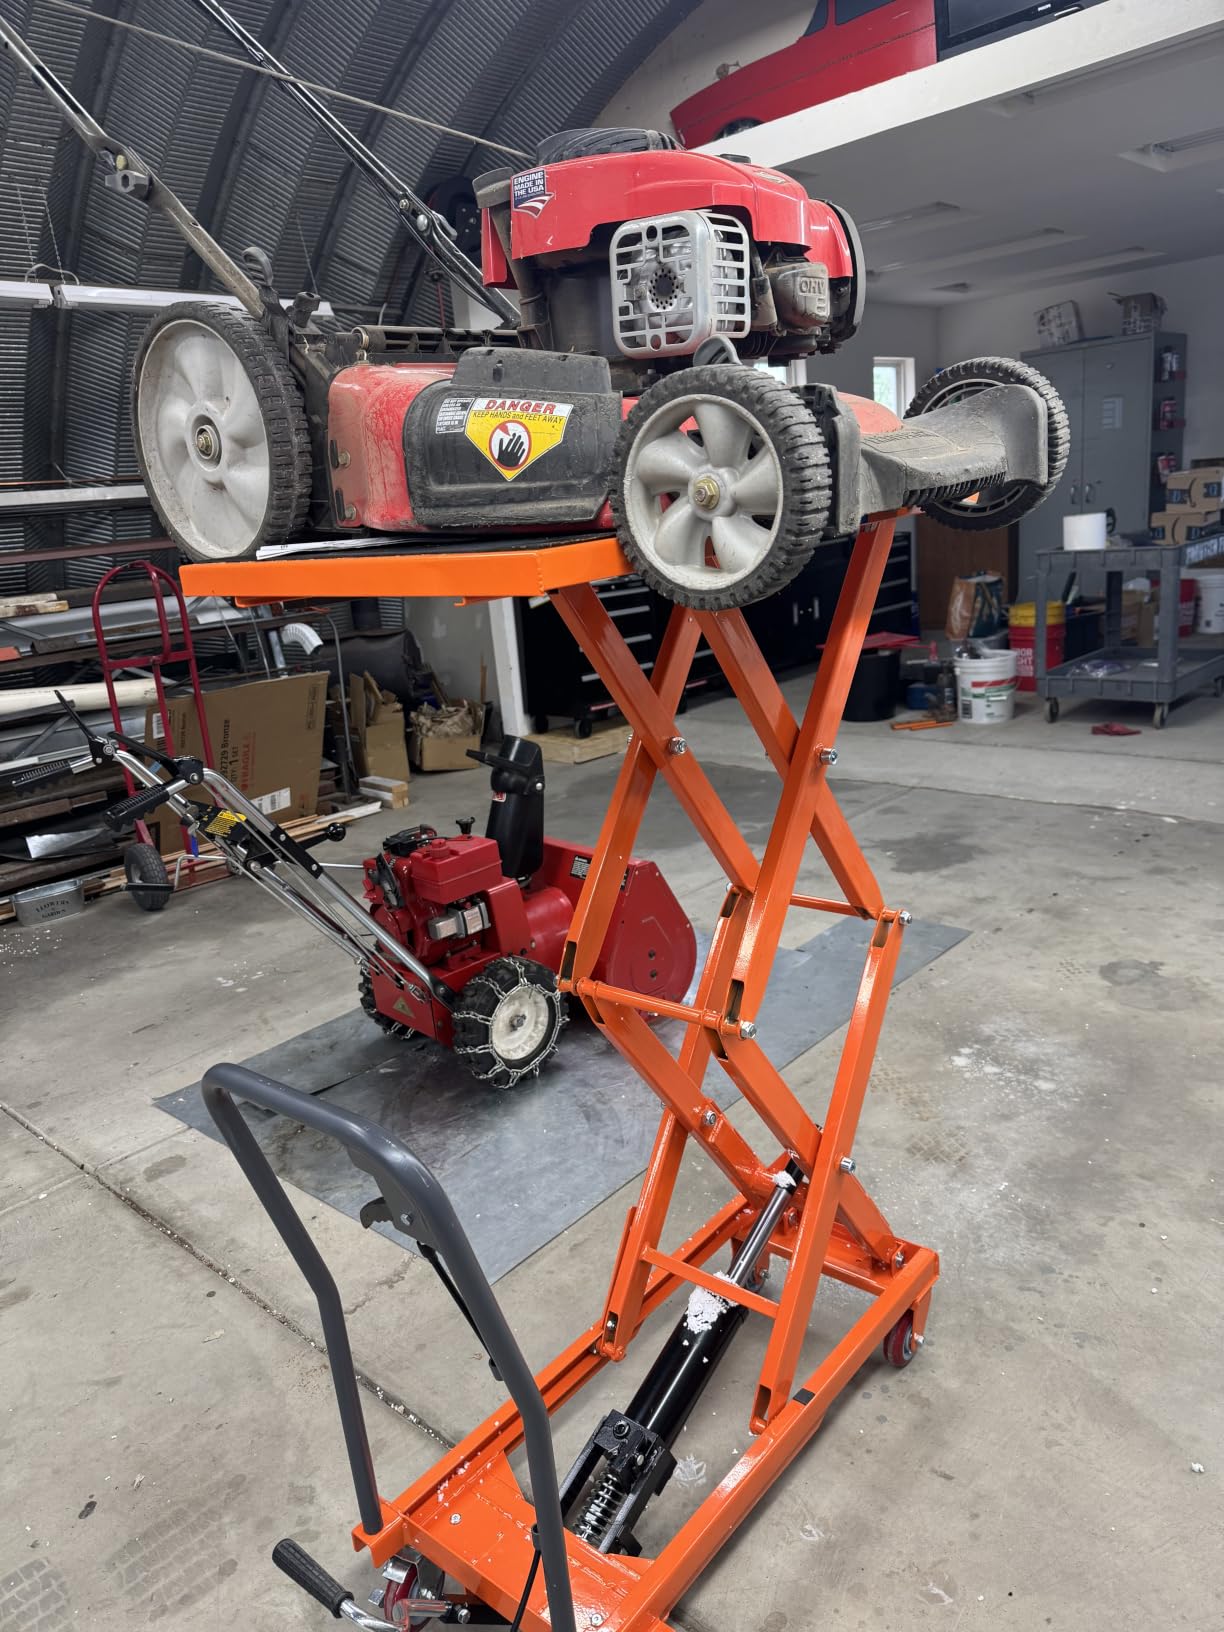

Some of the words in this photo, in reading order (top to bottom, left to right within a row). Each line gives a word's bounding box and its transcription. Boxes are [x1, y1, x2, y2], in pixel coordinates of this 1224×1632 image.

[514, 171, 544, 185] ENGINE
[514, 181, 534, 191] MADE
[514, 189, 527, 197] THE
[528, 185, 544, 193] USA
[485, 400, 556, 415] DANGER
[489, 411, 511, 419] HANDS
[512, 412, 523, 420] and
[525, 413, 541, 421] FEET
[543, 415, 565, 424] AWAY
[221, 719, 230, 748] Bronze
